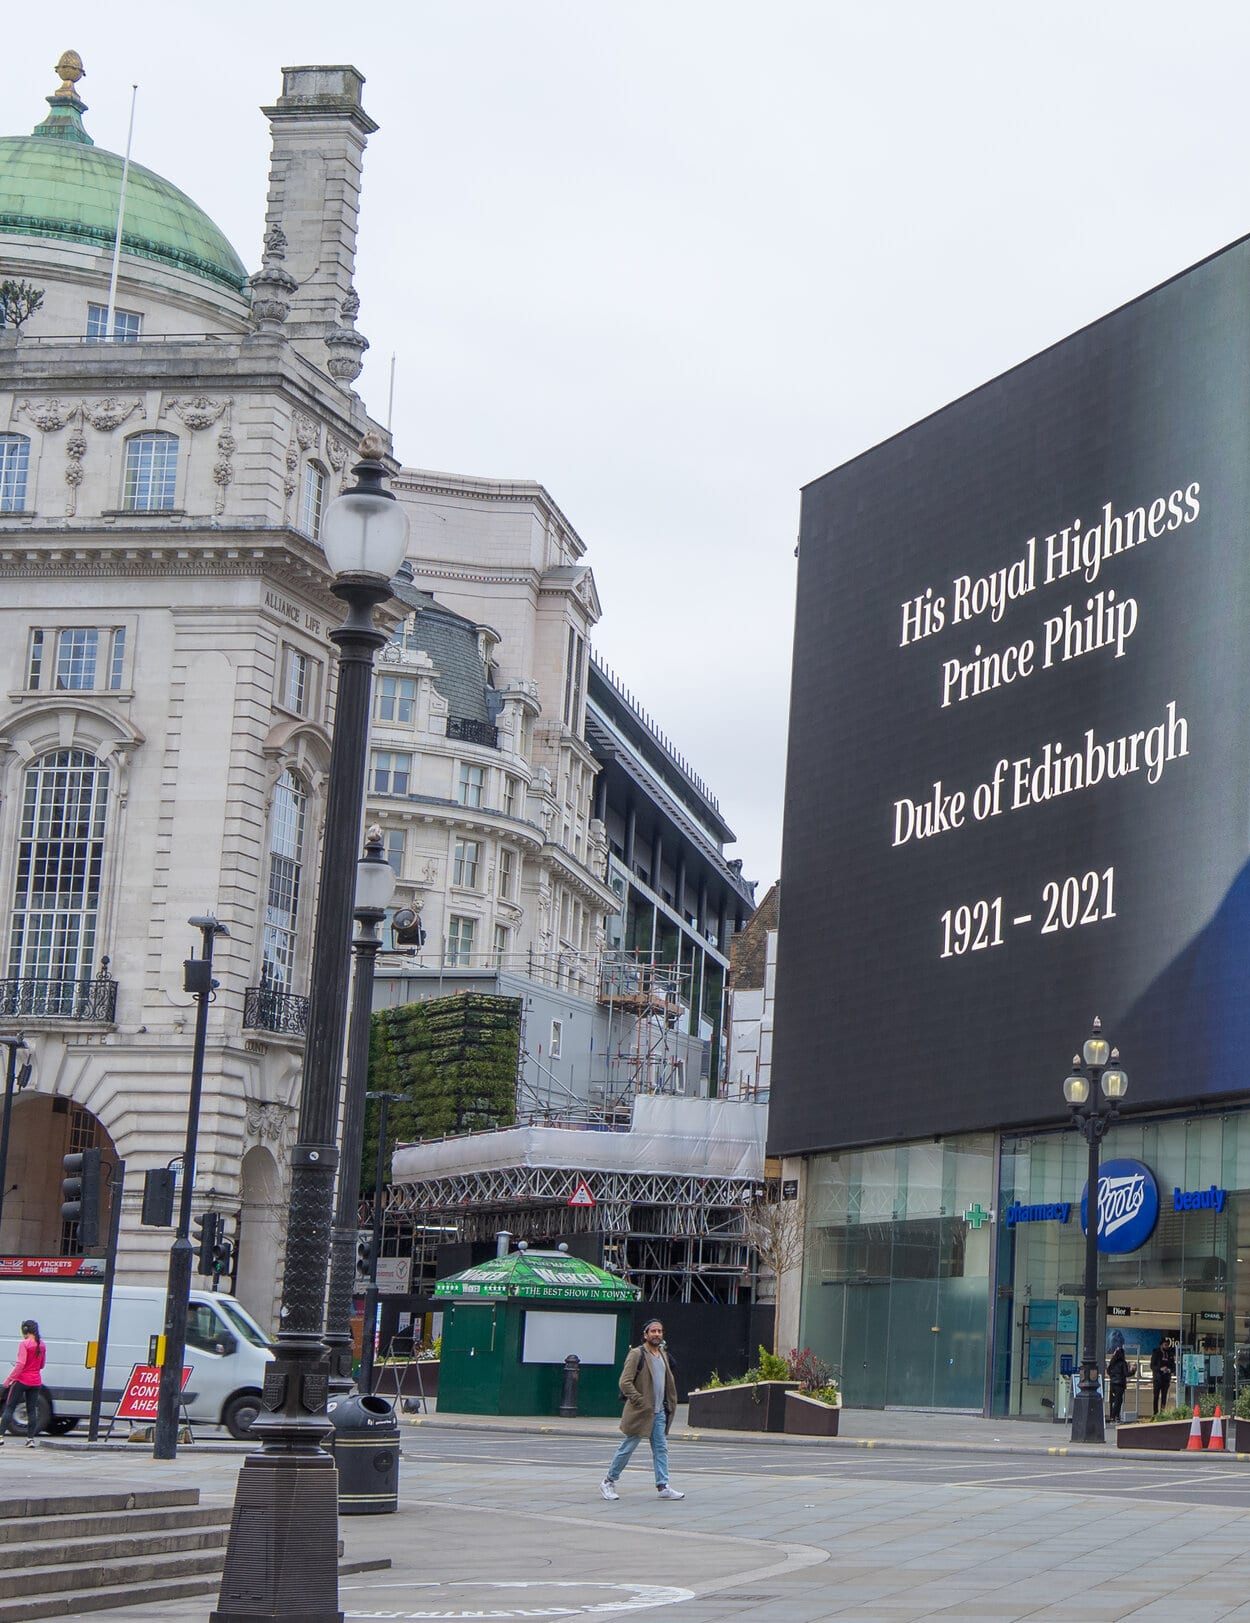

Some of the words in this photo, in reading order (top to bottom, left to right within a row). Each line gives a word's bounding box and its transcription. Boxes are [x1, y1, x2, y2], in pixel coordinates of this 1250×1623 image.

[899, 587, 945, 647] His
[951, 536, 1036, 623] Royal
[1044, 481, 1200, 584] Highness
[264, 591, 300, 623] ALLIANCE
[304, 614, 321, 635] LIFE
[940, 644, 1034, 708] Prince
[1042, 589, 1138, 669] Philip
[891, 781, 965, 847] Duke
[973, 759, 1008, 820] of
[1010, 700, 1190, 810] Edinburgh
[940, 897, 1004, 958] 1921
[1041, 867, 1117, 934] 2021
[1174, 1184, 1227, 1213] beauty
[1006, 1201, 1071, 1228] pharmacy
[543, 1287, 562, 1296] BEST
[564, 1288, 589, 1297] SHOW
[591, 1289, 600, 1297] IN
[1112, 1307, 1126, 1315] Dior
[1165, 1336, 1180, 1348] Dio
[130, 1385, 160, 1397] CONT
[139, 1372, 160, 1384] TRA
[130, 1399, 159, 1411] AHEA
